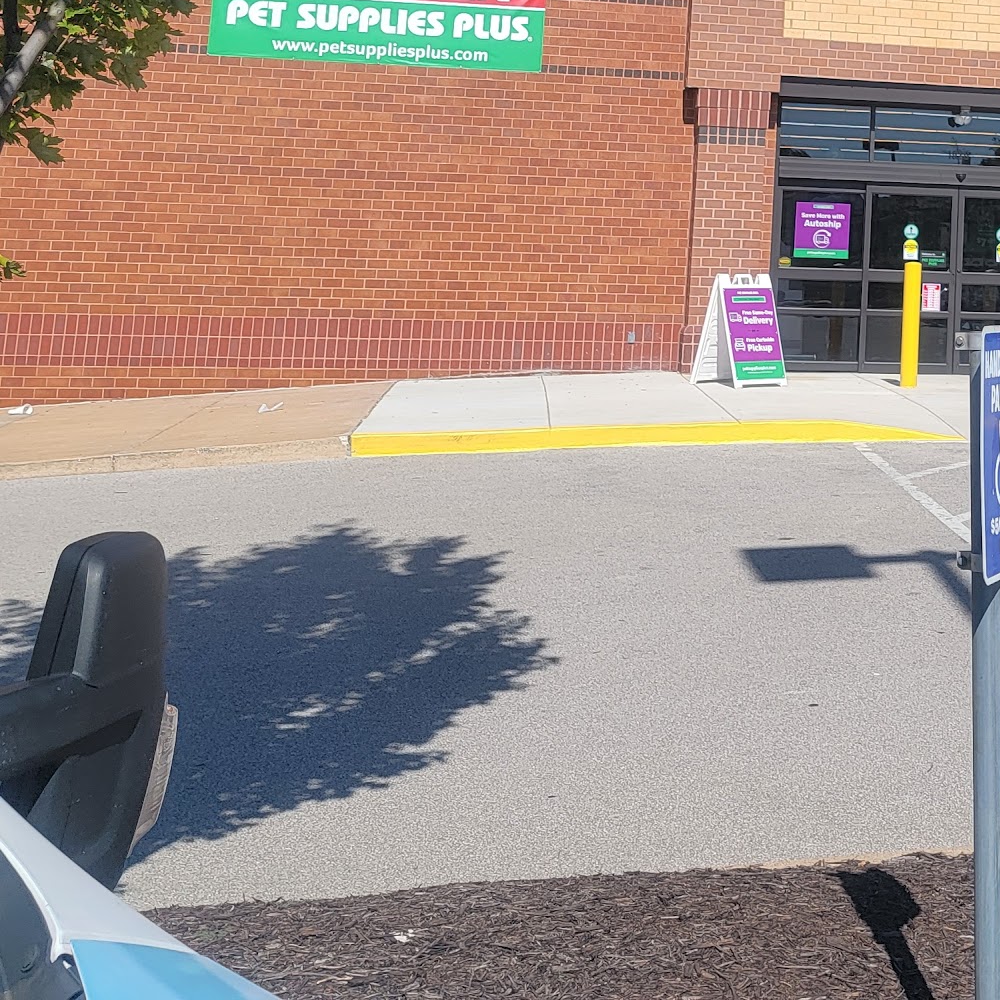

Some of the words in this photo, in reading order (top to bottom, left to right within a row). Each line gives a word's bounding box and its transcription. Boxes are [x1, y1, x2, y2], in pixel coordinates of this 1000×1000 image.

[295, 2, 446, 37] SUPPLIES
[271, 38, 489, 63] www.petsuppliesplus.com
[800, 211, 816, 219] Save
[816, 212, 831, 220] More
[803, 219, 842, 230] Autoship
[742, 316, 774, 327] Delivery
[746, 343, 774, 354] Pickup
